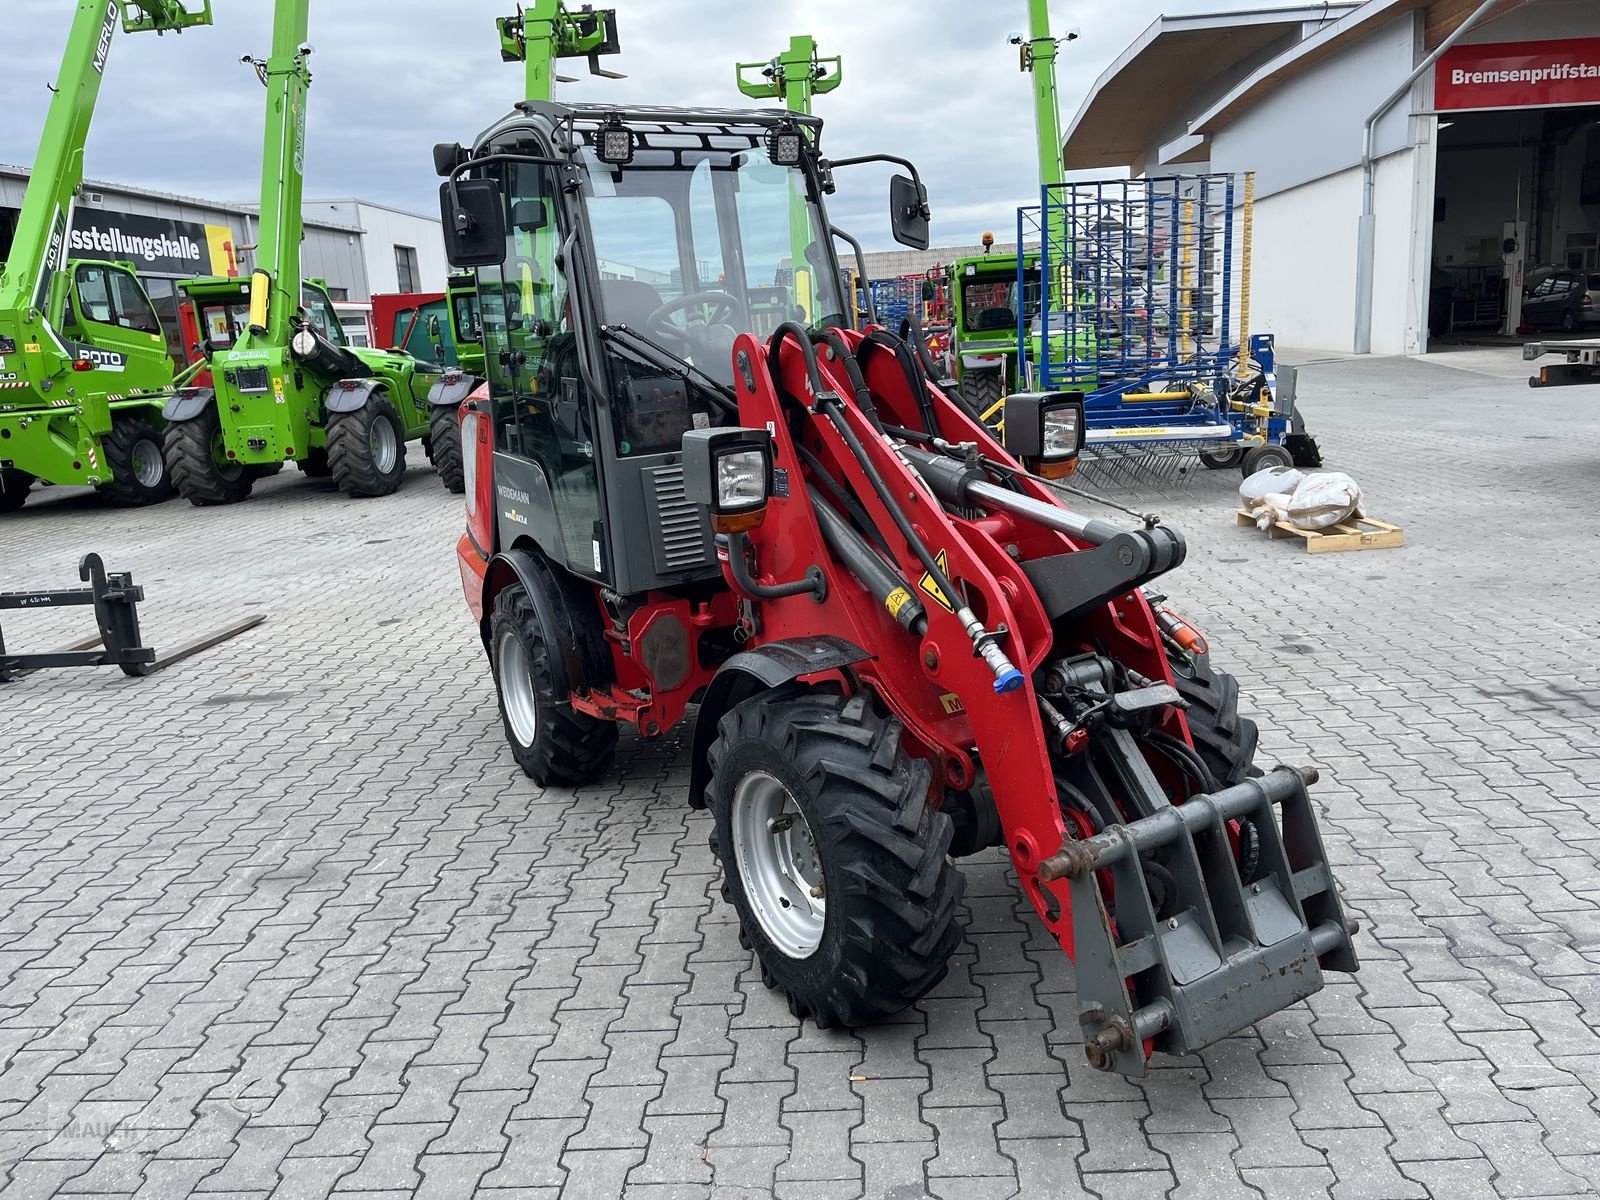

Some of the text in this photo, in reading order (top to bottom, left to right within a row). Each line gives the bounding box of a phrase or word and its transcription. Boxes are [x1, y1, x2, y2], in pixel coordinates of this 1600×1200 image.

[93, 1, 117, 73] MERLO
[47, 232, 60, 270] 40.16
[223, 241, 238, 277] 1
[80, 349, 121, 365] ROTO
[497, 484, 530, 505] WEIDEMANN
